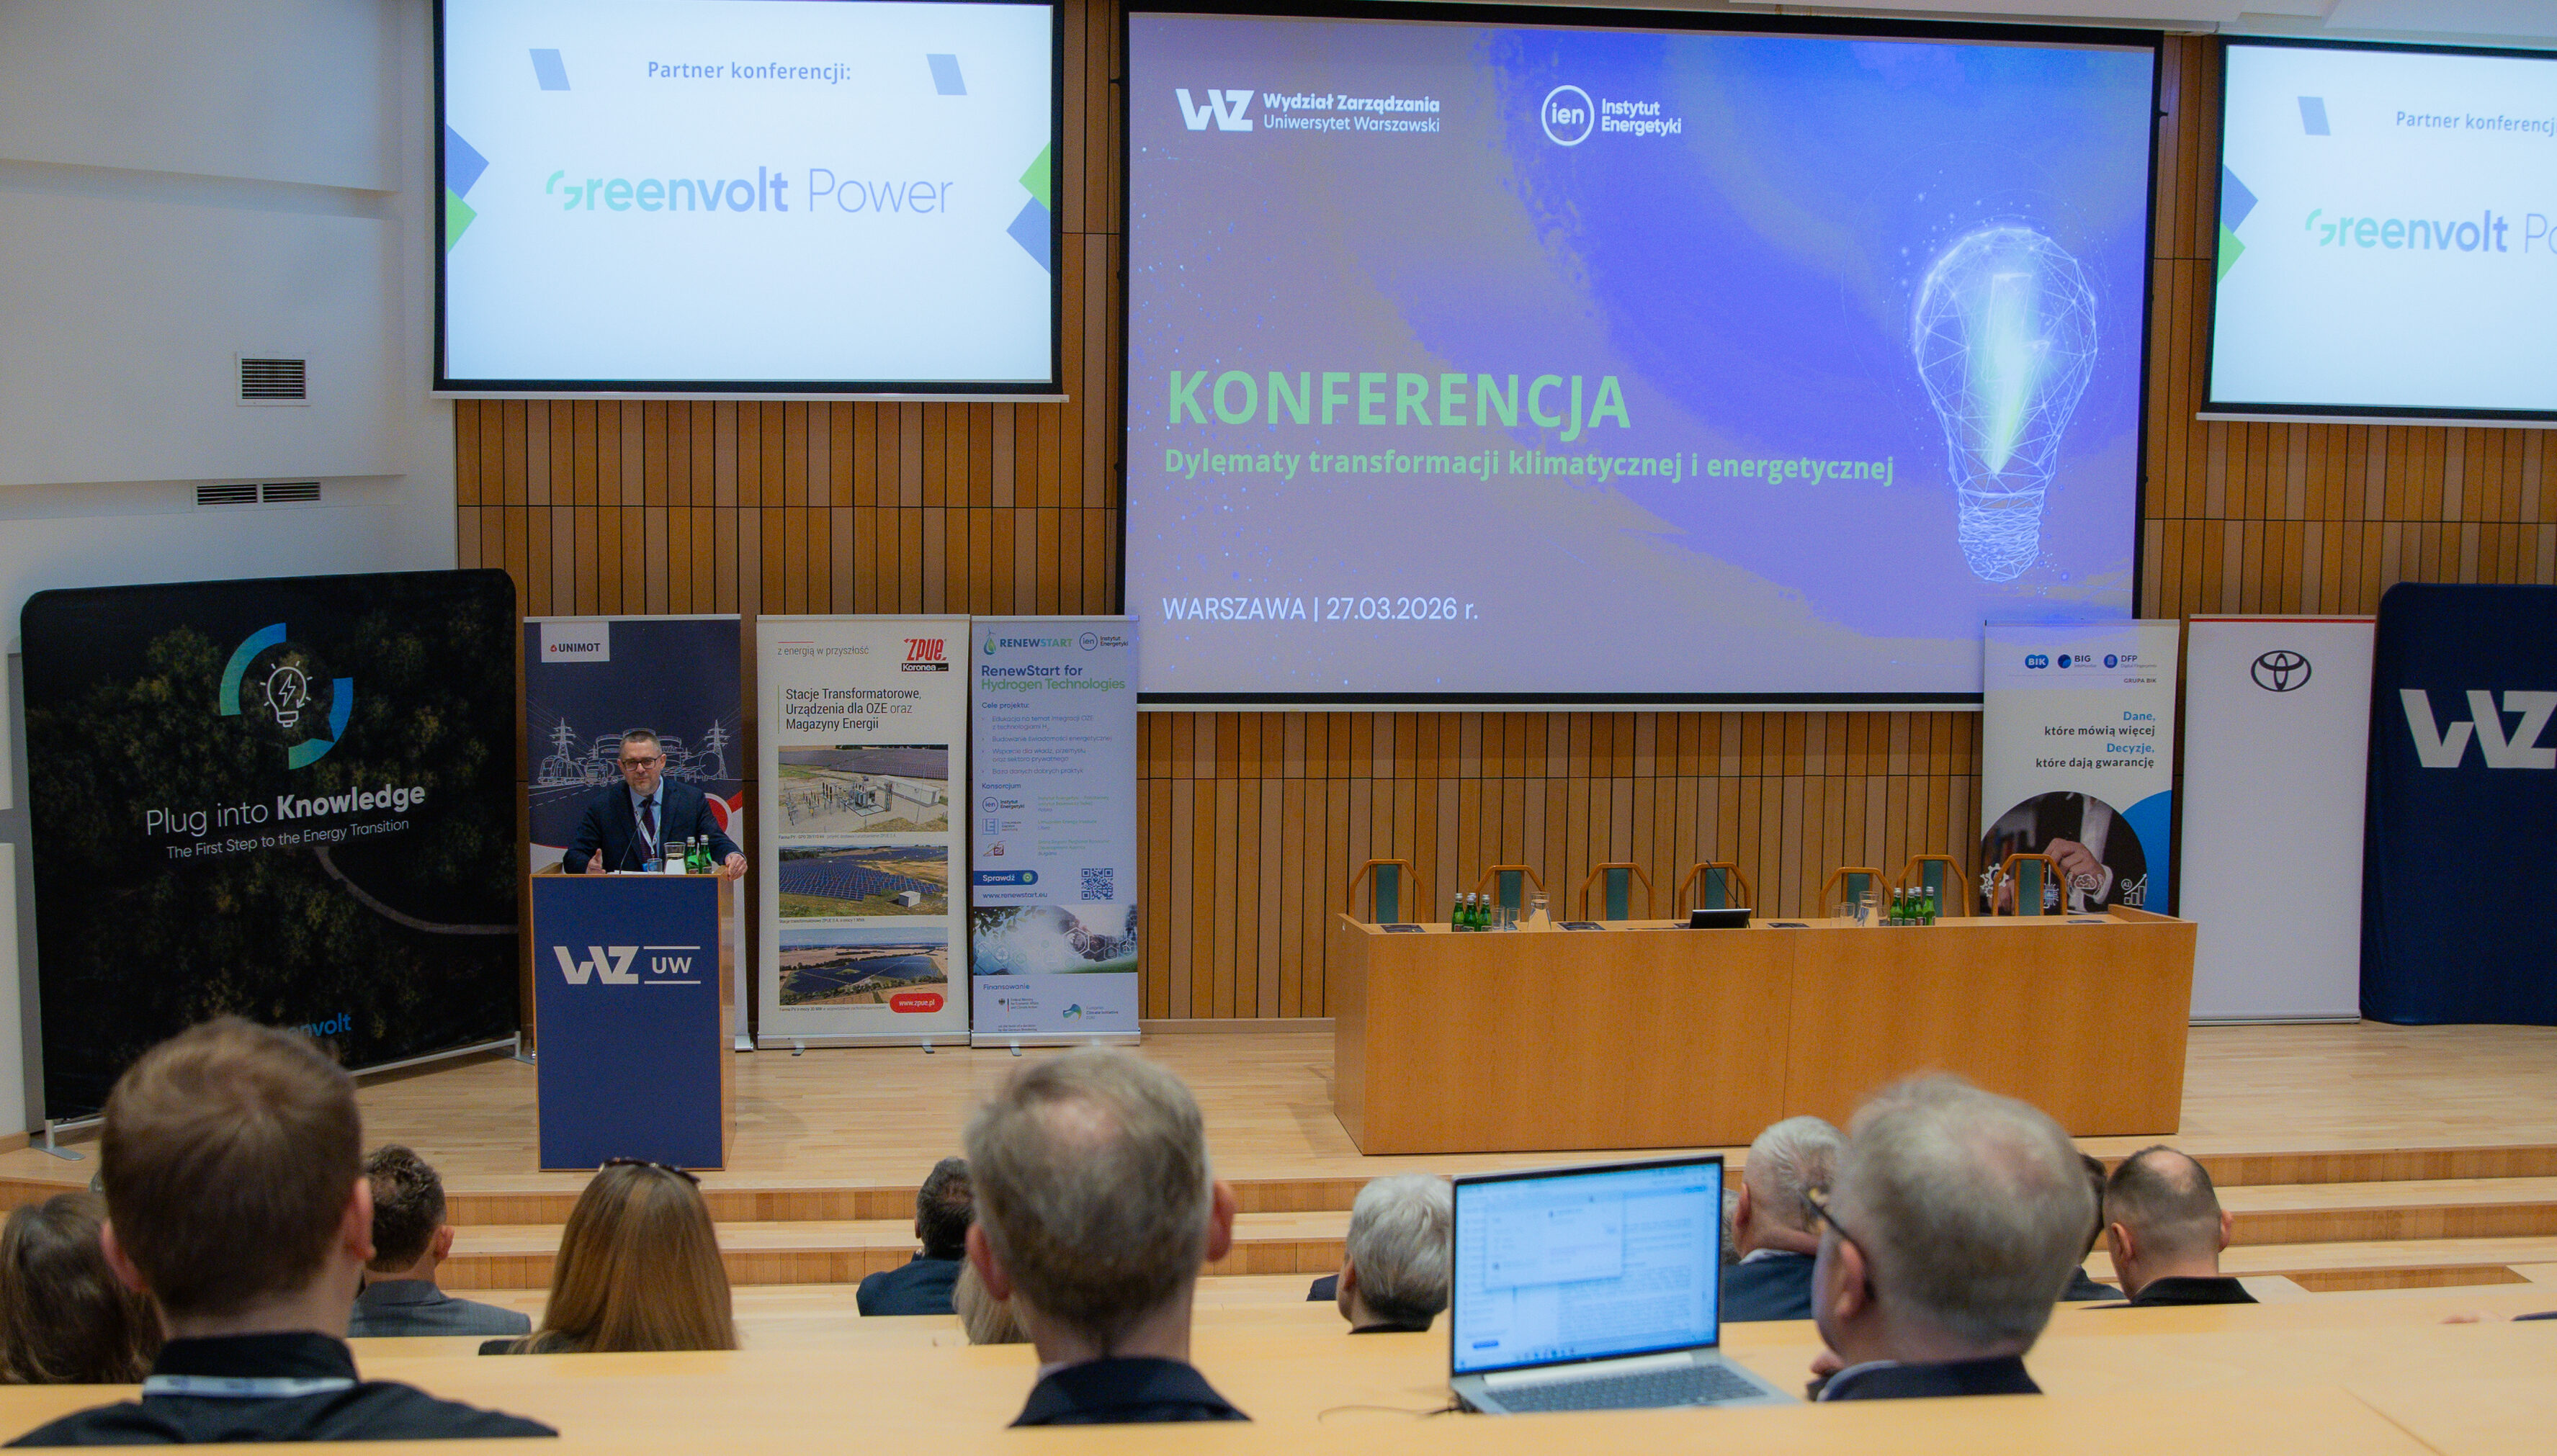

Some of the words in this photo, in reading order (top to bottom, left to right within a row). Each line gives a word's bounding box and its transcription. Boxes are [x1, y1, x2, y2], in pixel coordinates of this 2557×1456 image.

[648, 61, 725, 78] Partner
[731, 62, 852, 85] konferencji:
[1263, 91, 1335, 113] Wydział
[1337, 94, 1441, 114] Zarządzania
[1600, 98, 1660, 118] Instytut
[1551, 102, 1585, 125] ien
[1263, 114, 1351, 132] Uniwersytet
[1354, 115, 1440, 133] Warszawski
[1600, 117, 1682, 137] Energetyki
[2396, 110, 2460, 130] Partner
[2466, 113, 2557, 138] konferencj
[545, 166, 789, 212] Greenvolt
[809, 168, 954, 213] Power
[2304, 207, 2509, 253] Greenvolt
[1169, 369, 1631, 442] KONFERENCJA
[1165, 448, 1301, 480] Dylematy
[1308, 449, 1500, 482] transformacji
[1509, 451, 1683, 483] klimatycznej
[1691, 453, 1698, 477] i
[1706, 457, 1895, 486] energetycznej
[1162, 596, 1307, 620] WARSZAWA
[1326, 596, 1458, 620] 27.03.2026
[1464, 602, 1479, 620] r.
[558, 642, 601, 652] UNIMOT
[784, 646, 815, 657] energią
[825, 645, 869, 657] przyszłość
[1000, 638, 1073, 647] RENEWSTART
[981, 665, 1060, 676] RenewStart
[1064, 665, 1083, 676] for
[2028, 657, 2047, 666] BIK
[981, 678, 1042, 692] Hydrogen
[1044, 678, 1126, 692] Technologies
[786, 688, 820, 704] Stacje
[822, 688, 922, 700] Transformatorowe,
[786, 703, 844, 717] Urządzenia
[848, 702, 864, 714] dla
[866, 703, 888, 714] OZE
[890, 704, 913, 714] oraz
[2123, 711, 2156, 722] Dane,
[786, 719, 840, 732] Magazyny
[843, 717, 879, 732] Energii
[2044, 726, 2075, 736] które
[2078, 725, 2115, 737] mówią
[2118, 725, 2156, 737] więcej
[2107, 742, 2155, 755] Decyzje,
[2036, 758, 2066, 768] które
[2069, 758, 2092, 769] dają
[2095, 757, 2154, 769] gwarancję
[146, 807, 208, 837] Plug
[217, 801, 269, 828] into
[277, 783, 426, 821] Knowledge
[166, 845, 192, 860] The
[195, 841, 223, 856] First
[225, 837, 258, 854] Step
[261, 835, 275, 848] to
[278, 832, 300, 845] the
[304, 826, 347, 842] Energy
[350, 818, 409, 837] Transition
[552, 945, 640, 984] WZ
[651, 956, 692, 974] UW
[898, 999, 935, 1007] www.zpue.pl
